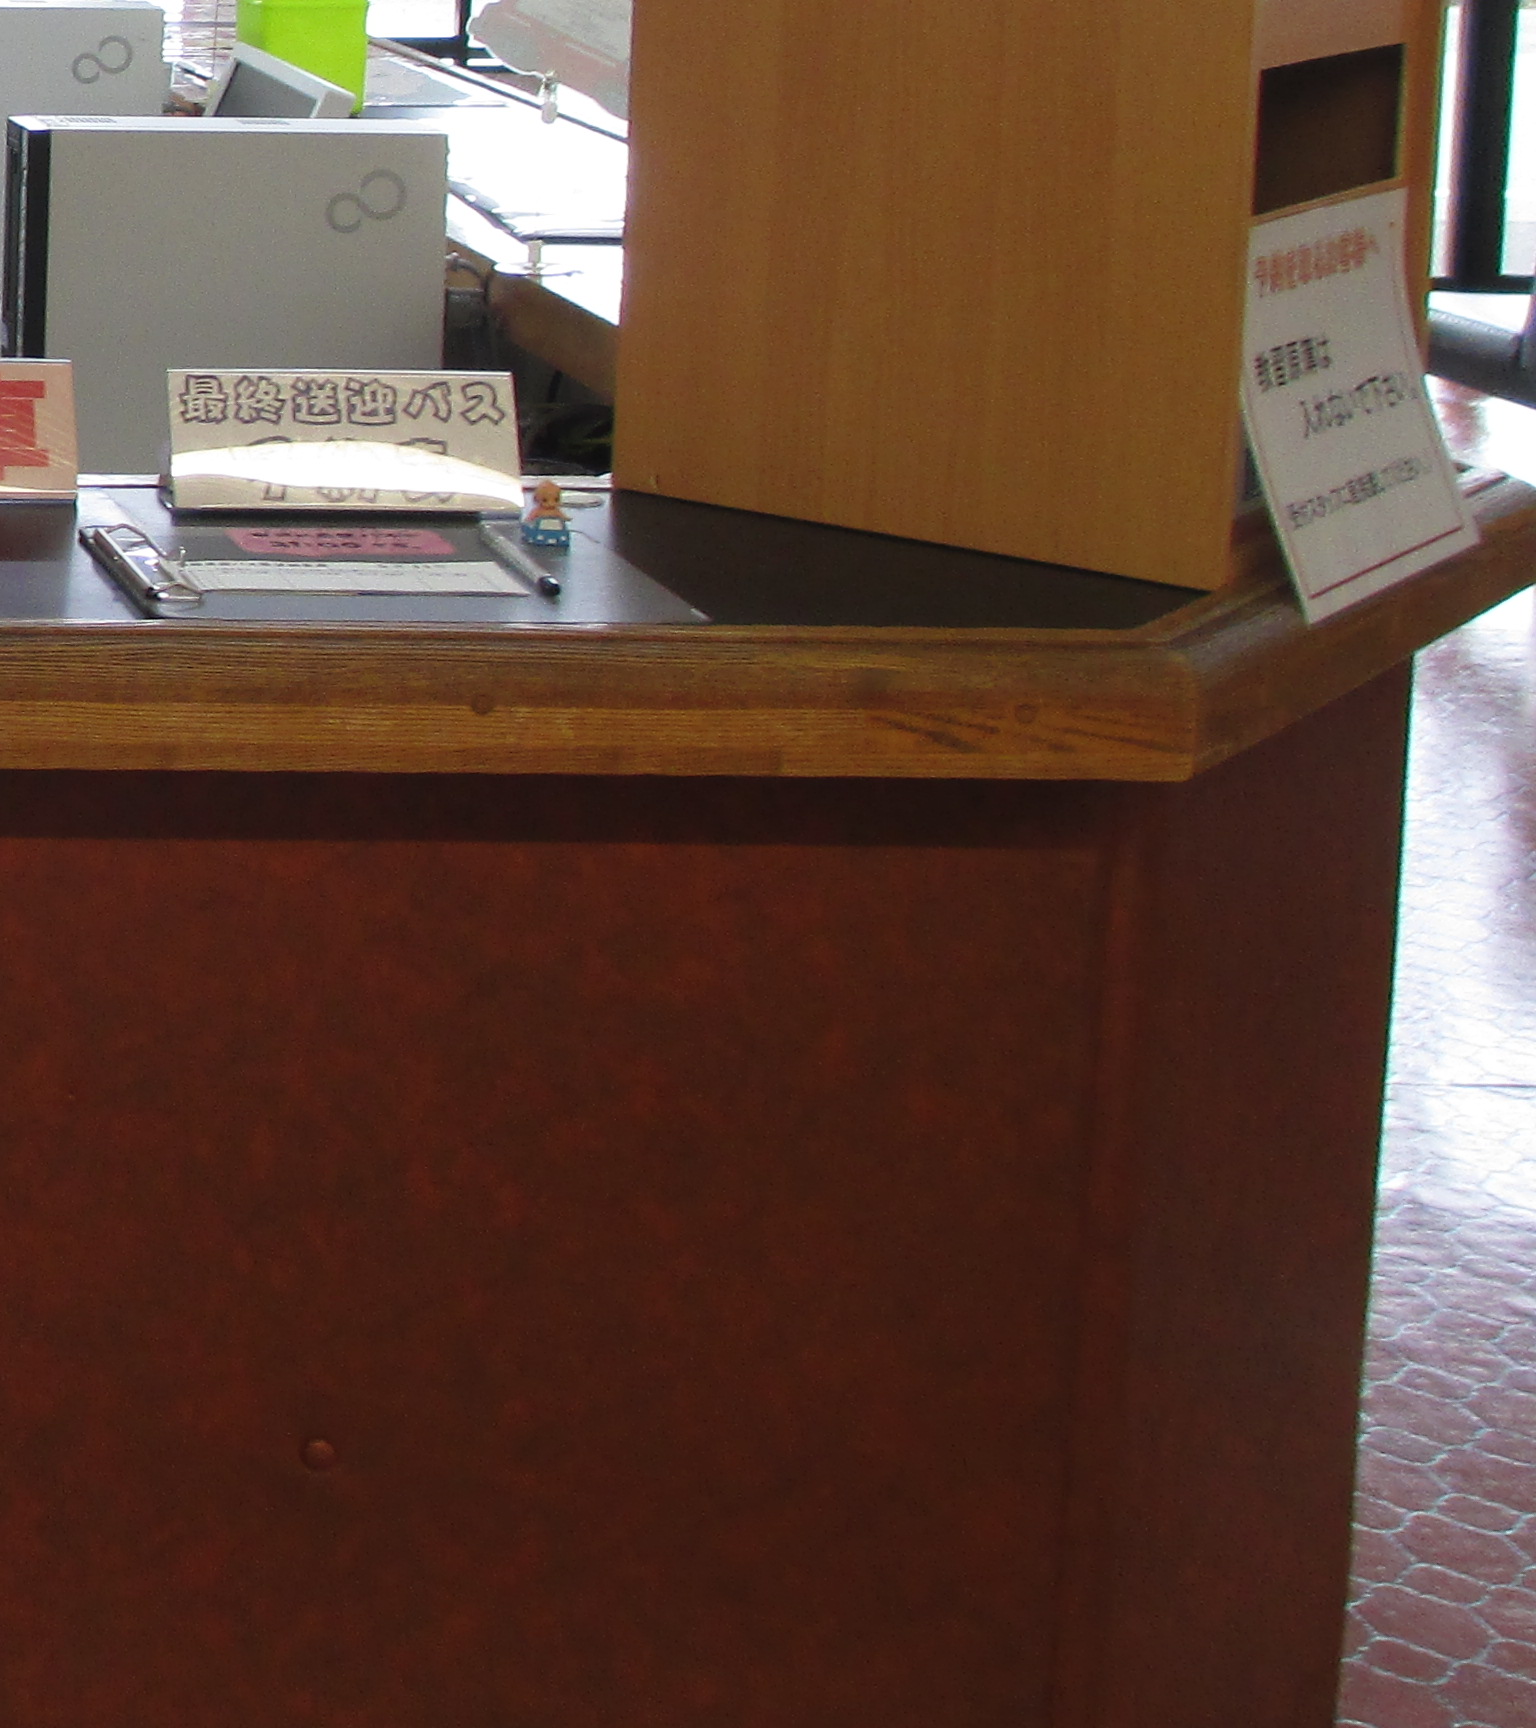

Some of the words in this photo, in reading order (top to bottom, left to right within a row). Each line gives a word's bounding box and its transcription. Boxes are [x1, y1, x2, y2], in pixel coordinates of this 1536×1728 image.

[179, 374, 505, 426] 最終送迎バス
